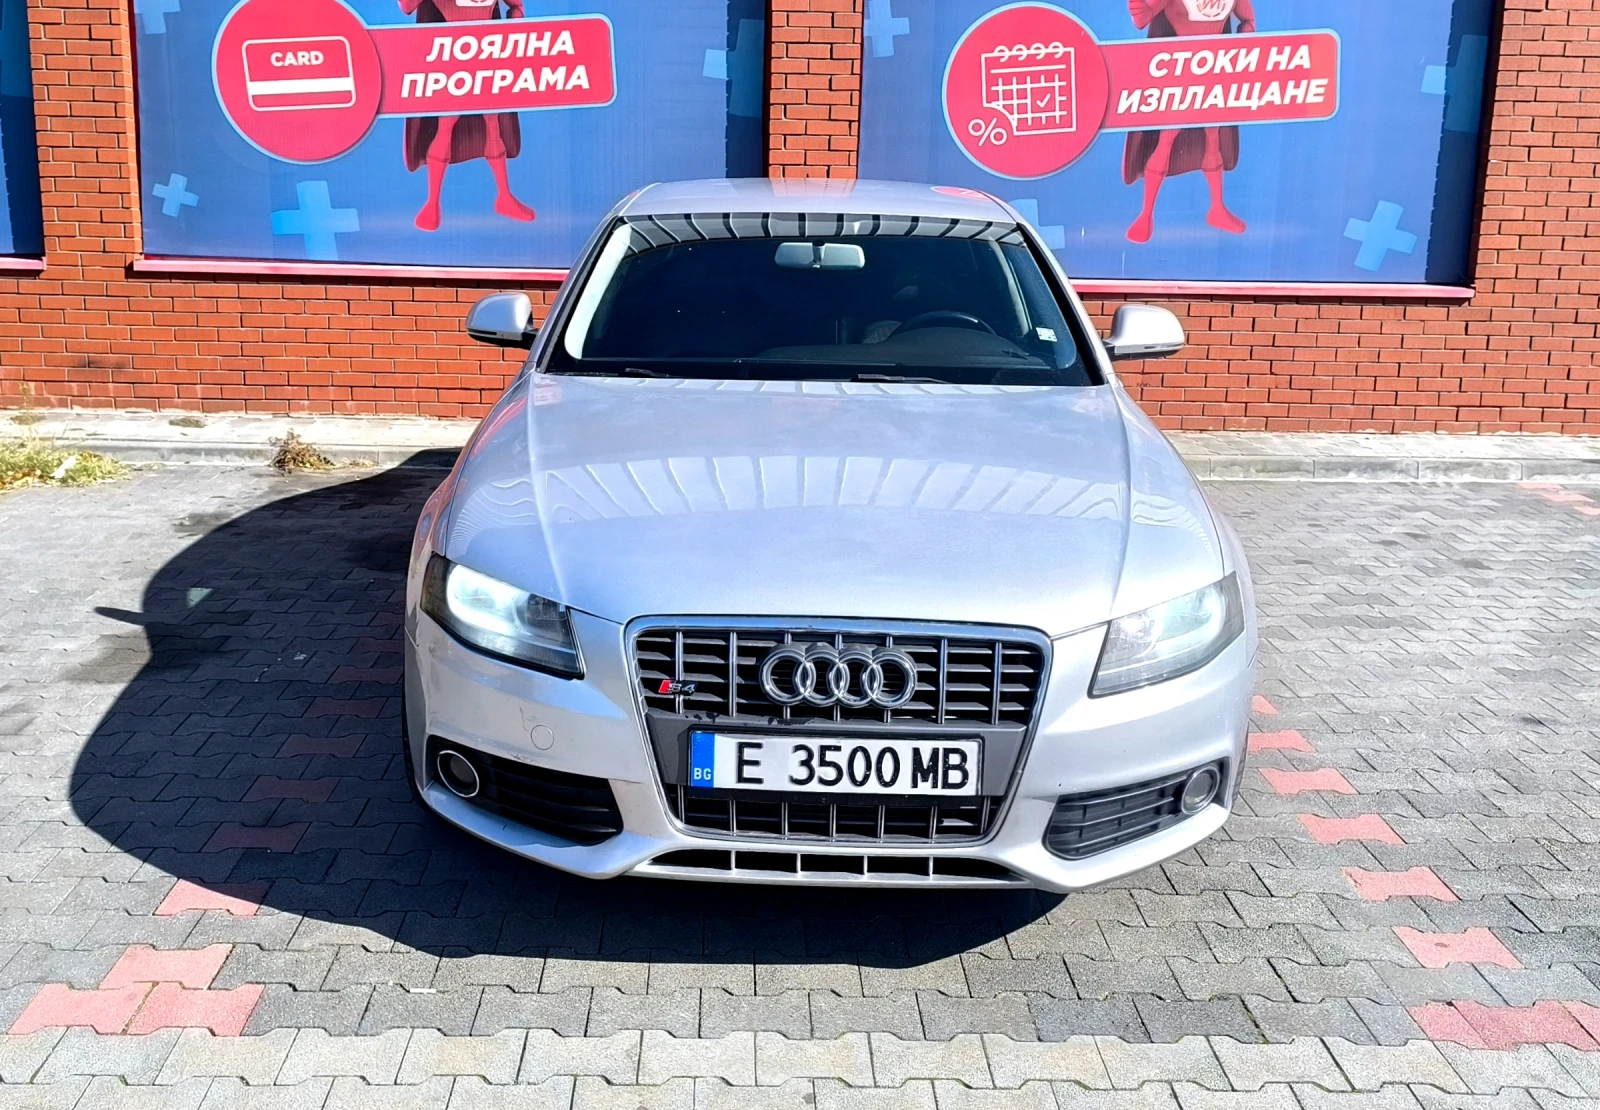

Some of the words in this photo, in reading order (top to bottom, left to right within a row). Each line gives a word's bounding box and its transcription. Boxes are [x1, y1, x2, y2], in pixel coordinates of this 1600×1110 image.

[270, 50, 324, 67] CARD
[425, 30, 575, 62] ЛОЯЛНА
[1148, 47, 1260, 78] СТОКИ
[1265, 44, 1311, 71] НА
[400, 65, 590, 98] ПРОГРАМА
[1116, 78, 1329, 115] ИЗПЛАЩАНЕ
[693, 767, 712, 781] BG
[736, 741, 764, 785] E
[788, 744, 901, 788] 3500
[910, 746, 970, 790] MB
